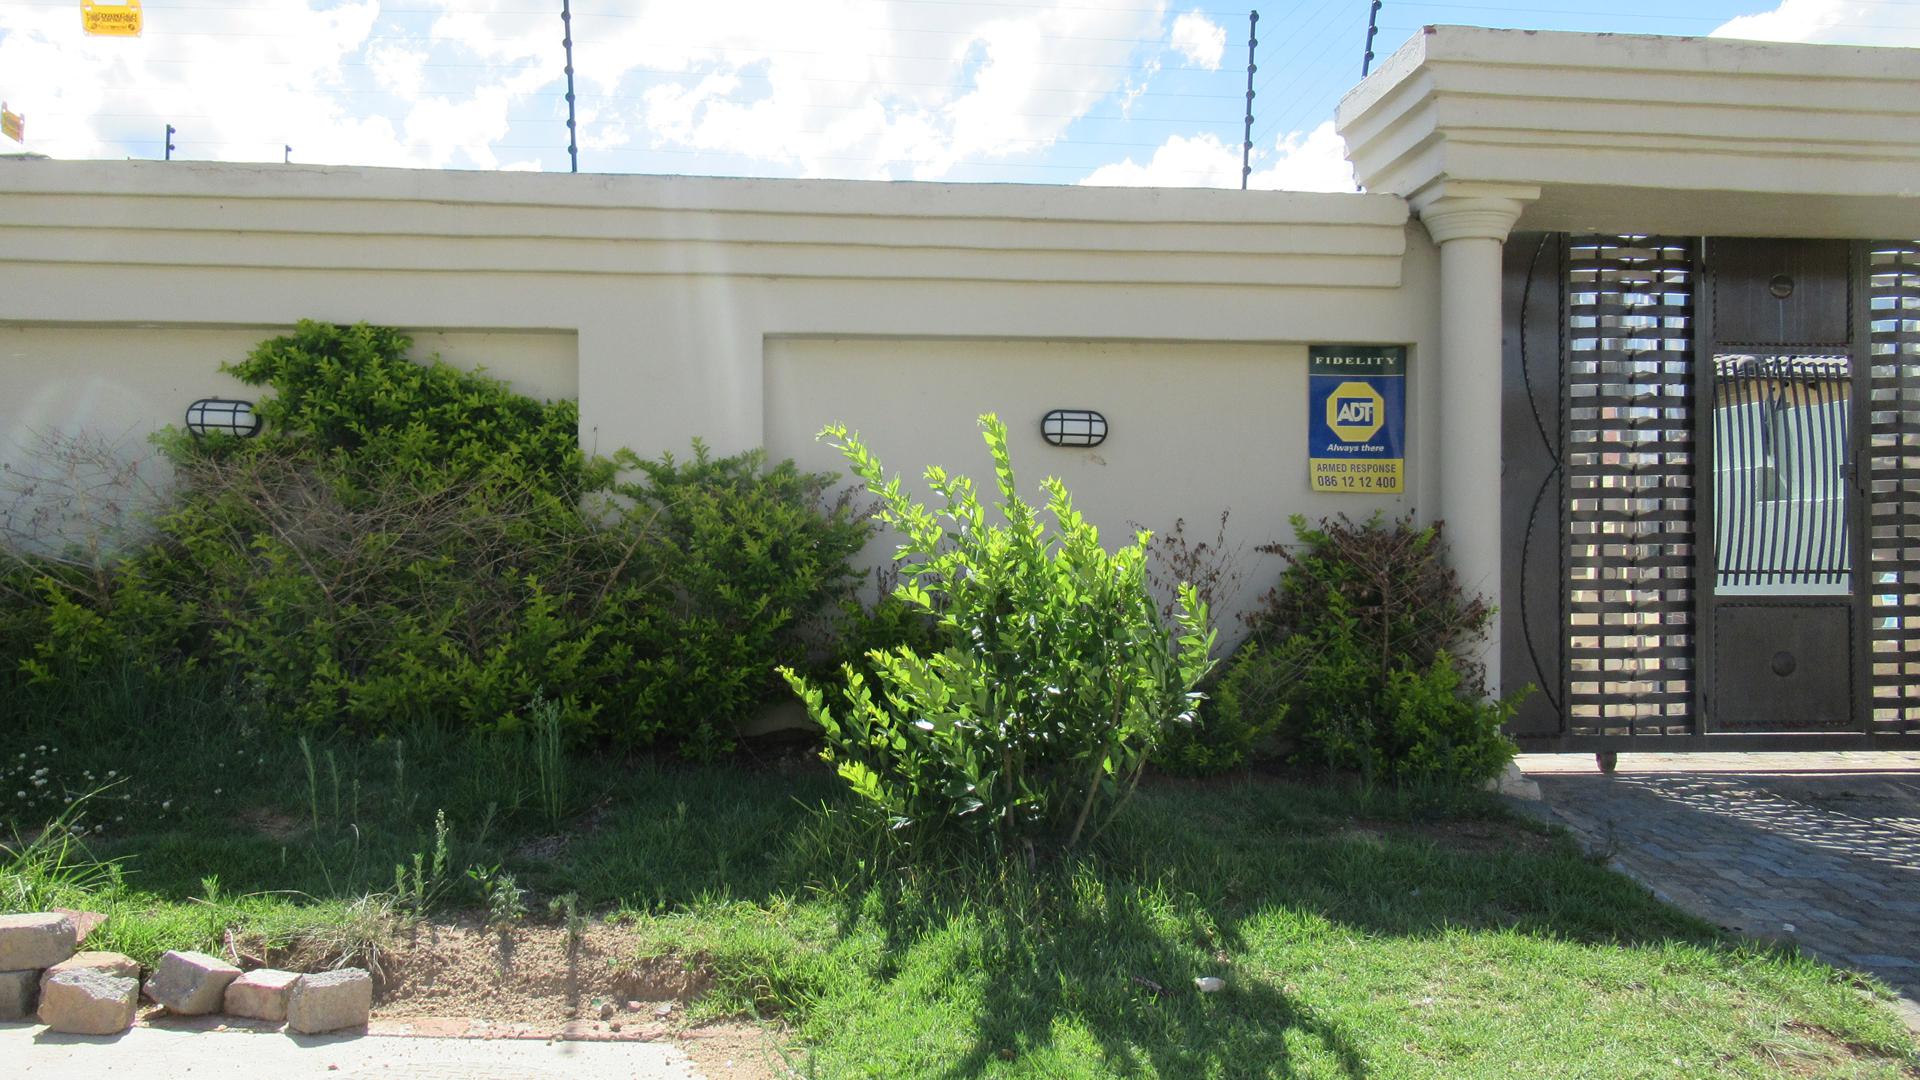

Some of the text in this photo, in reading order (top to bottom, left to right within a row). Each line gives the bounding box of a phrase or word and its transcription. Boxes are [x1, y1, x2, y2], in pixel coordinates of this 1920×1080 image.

[1315, 356, 1397, 365] FIDELITY
[1337, 402, 1373, 422] ADT
[1326, 443, 1384, 453] Always there
[1316, 463, 1396, 473] ARMED RESPONSE
[1317, 475, 1396, 488] 086 12 12 400
